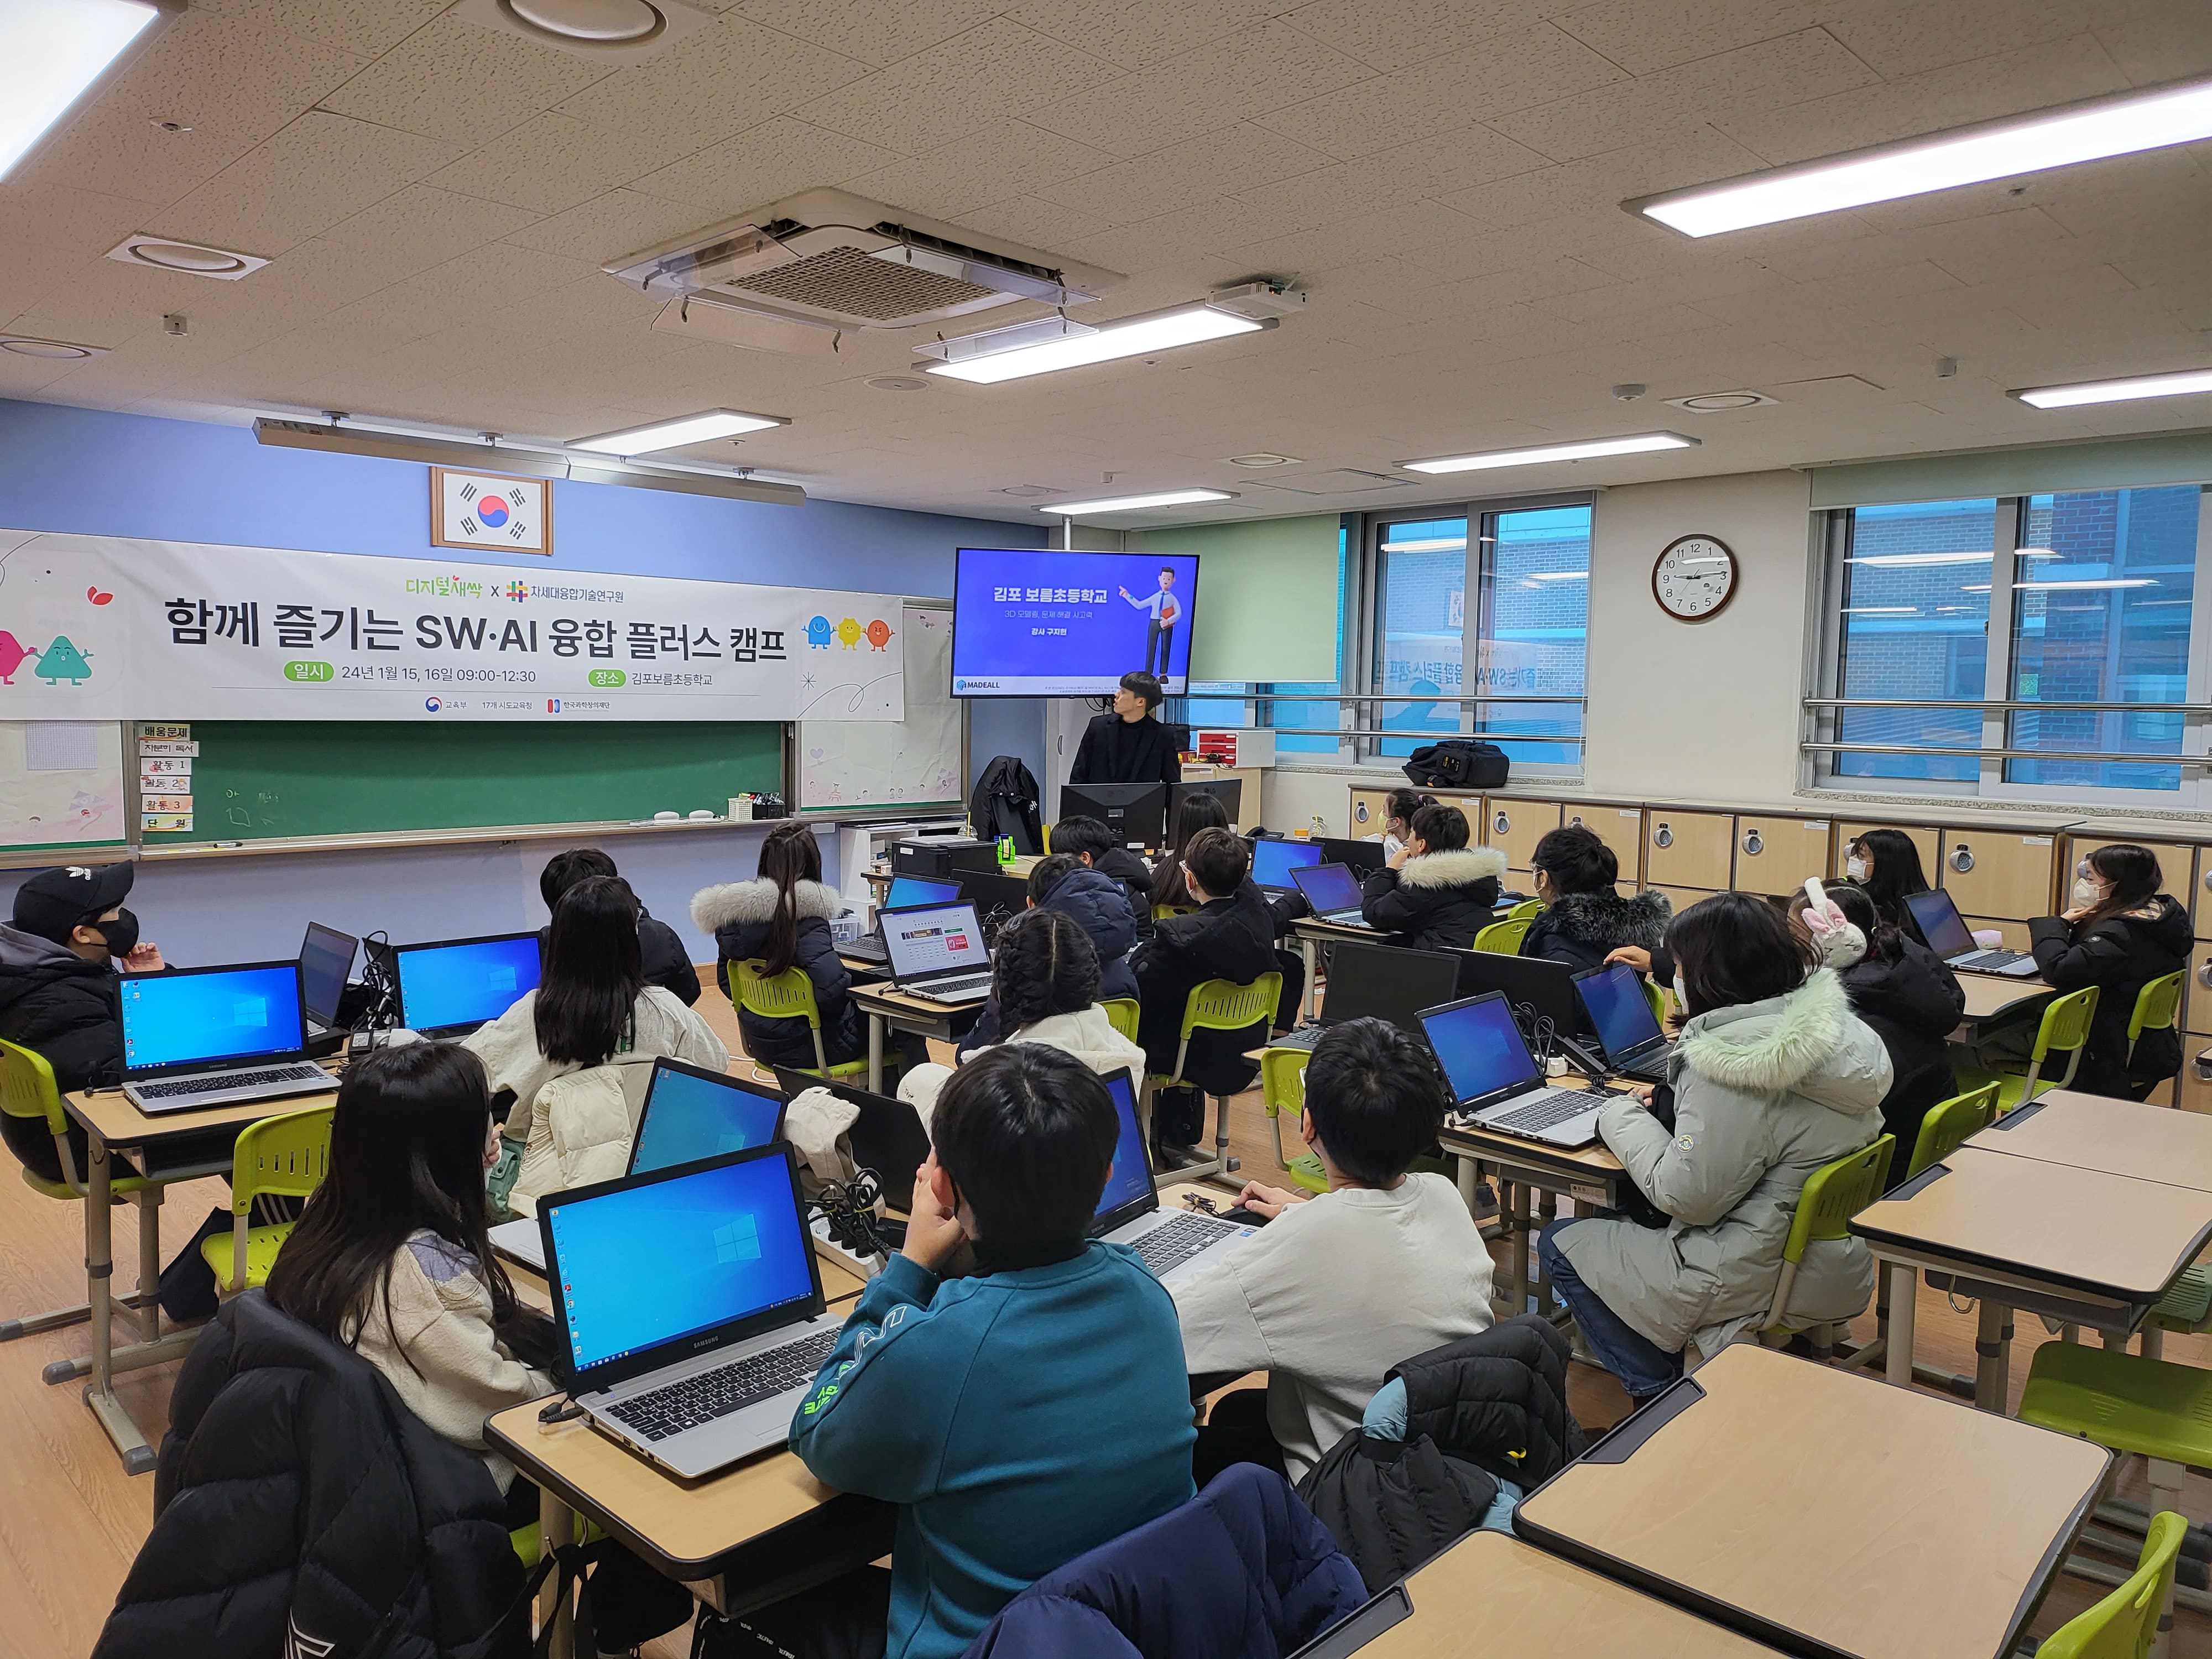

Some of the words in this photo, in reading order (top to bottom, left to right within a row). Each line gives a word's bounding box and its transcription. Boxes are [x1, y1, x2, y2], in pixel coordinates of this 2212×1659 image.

[1690, 544, 1700, 553] 12
[1708, 546, 1712, 556] 1
[1676, 549, 1684, 558] 11
[1665, 560, 1675, 569] 10
[1663, 575, 1670, 583] 9
[1720, 571, 1727, 580] 3
[406, 576, 482, 599] 디지털새싹
[530, 585, 624, 603] 차세대융합기술연구원
[1666, 588, 1673, 597] 8
[1715, 586, 1722, 595] 4
[994, 587, 1022, 602] 김포
[1025, 587, 1108, 604] 보름초등학교
[1676, 599, 1683, 608] 7
[1690, 602, 1697, 611] 6
[1704, 597, 1711, 607] 5
[1004, 610, 1016, 618] 3D
[1041, 611, 1056, 619] 문제
[164, 597, 259, 648] 함께
[273, 604, 404, 651] 즐기는
[415, 614, 538, 653] SW·AI
[548, 618, 618, 659] 융합
[625, 622, 722, 661] 플러스
[729, 627, 787, 663] 캠프
[1031, 628, 1046, 636] 강사
[294, 663, 324, 680] 일시
[341, 665, 374, 680] 24년
[378, 666, 398, 681] 1월
[401, 667, 420, 683] 15,
[424, 667, 453, 682] 16일
[456, 669, 536, 682] 09:00-12:30
[595, 671, 619, 685] 장소
[631, 672, 713, 687] 김포보름초등학교
[445, 701, 467, 709] 교육부
[482, 701, 498, 710] 17개
[499, 701, 533, 710] 시도교육청
[144, 726, 187, 738] 배움문제
[153, 760, 174, 770] 활동
[180, 760, 185, 769] 1
[144, 779, 166, 788] 활동
[172, 779, 178, 787] 2
[146, 800, 168, 811] 활동
[174, 801, 180, 809] 3
[147, 818, 158, 828] 단
[175, 818, 185, 828] 원
